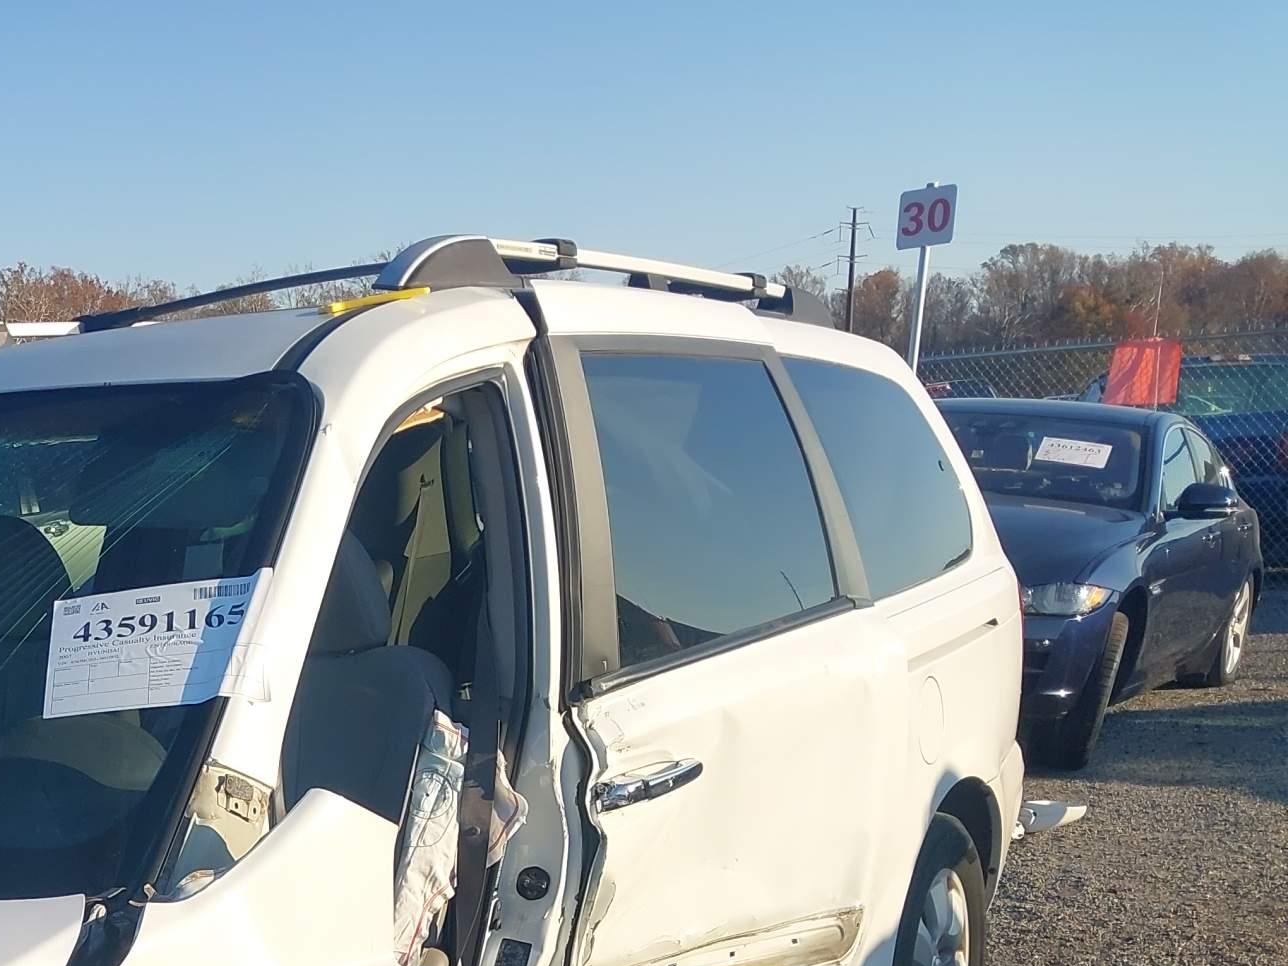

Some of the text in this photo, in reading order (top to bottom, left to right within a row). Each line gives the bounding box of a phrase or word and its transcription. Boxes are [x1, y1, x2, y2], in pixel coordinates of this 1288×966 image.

[902, 198, 951, 236] 30
[72, 601, 247, 643] 43591165
[58, 641, 110, 653] Progressive
[112, 635, 150, 647] Casualty
[153, 632, 197, 642] Insurance
